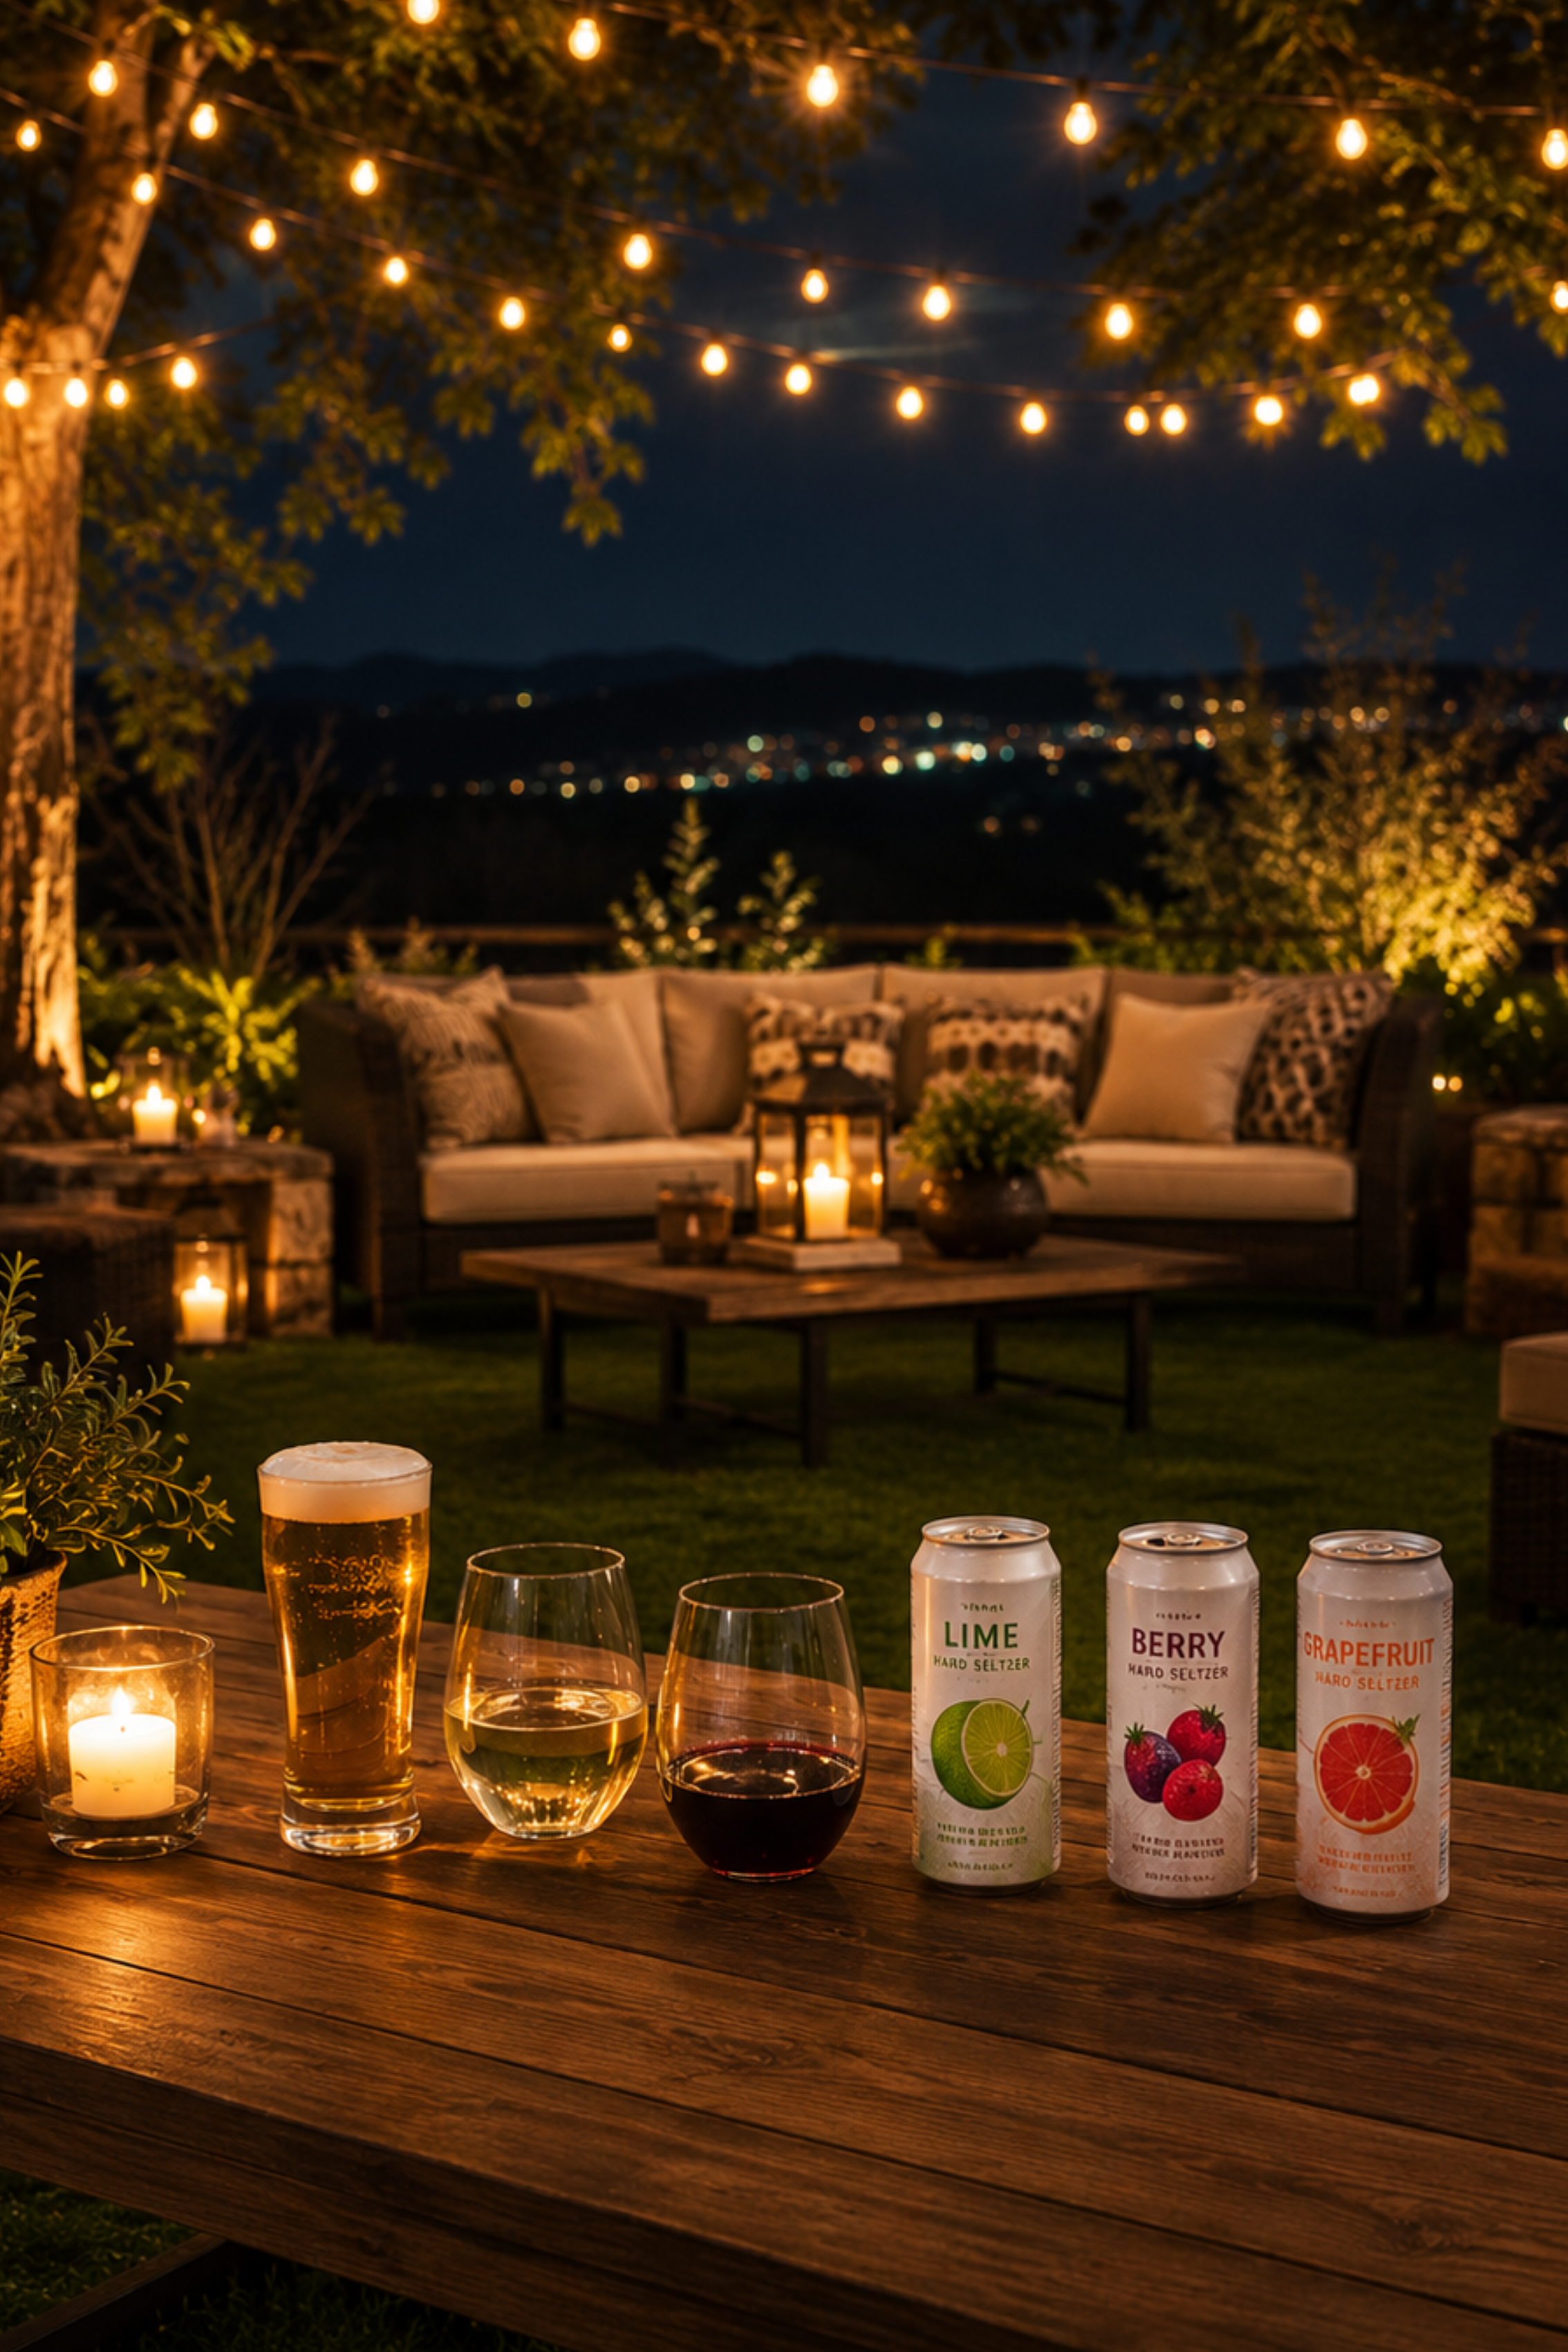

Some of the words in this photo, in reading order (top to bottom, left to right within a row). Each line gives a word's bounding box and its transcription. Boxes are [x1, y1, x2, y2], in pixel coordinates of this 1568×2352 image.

[944, 1621, 1018, 1650] LIME
[1132, 1627, 1226, 1659] BERRY
[1304, 1630, 1435, 1668] GRAPEFRUIT
[933, 1655, 967, 1670] HARD
[973, 1656, 1030, 1672] SELTZER
[1128, 1662, 1164, 1679] HARD
[1170, 1665, 1229, 1681] SELTZER
[1357, 1674, 1419, 1691] SELTZER
